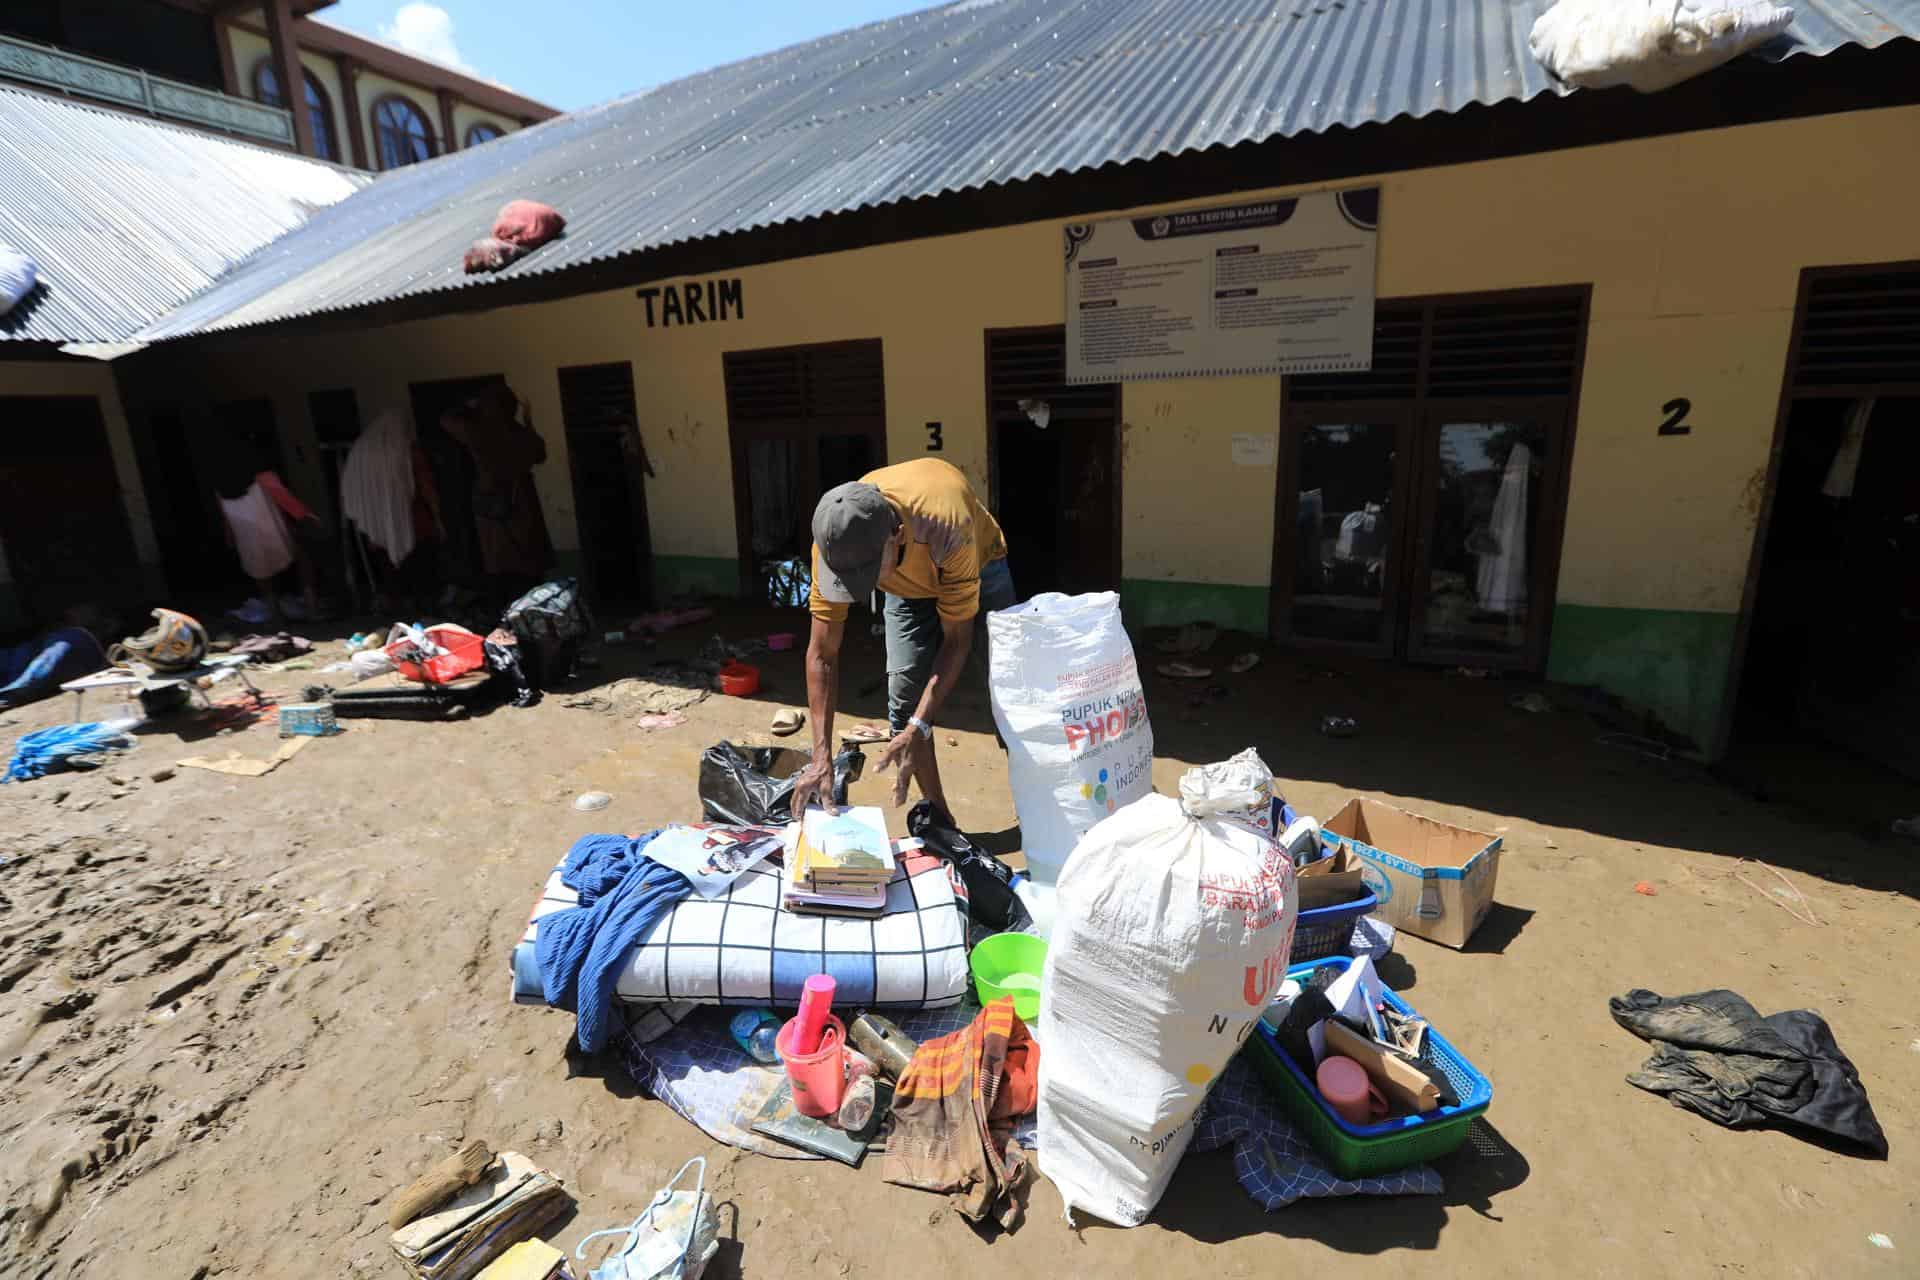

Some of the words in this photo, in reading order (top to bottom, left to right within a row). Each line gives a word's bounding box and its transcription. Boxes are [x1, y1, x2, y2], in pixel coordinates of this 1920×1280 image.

[1174, 215, 1199, 226] TATA
[1199, 209, 1236, 224] TERTIB
[1237, 204, 1278, 218] KAMAR
[637, 279, 744, 327] TARIM
[1657, 397, 1691, 436] 2
[926, 422, 943, 451] 3
[1062, 696, 1113, 723] PUPUK
